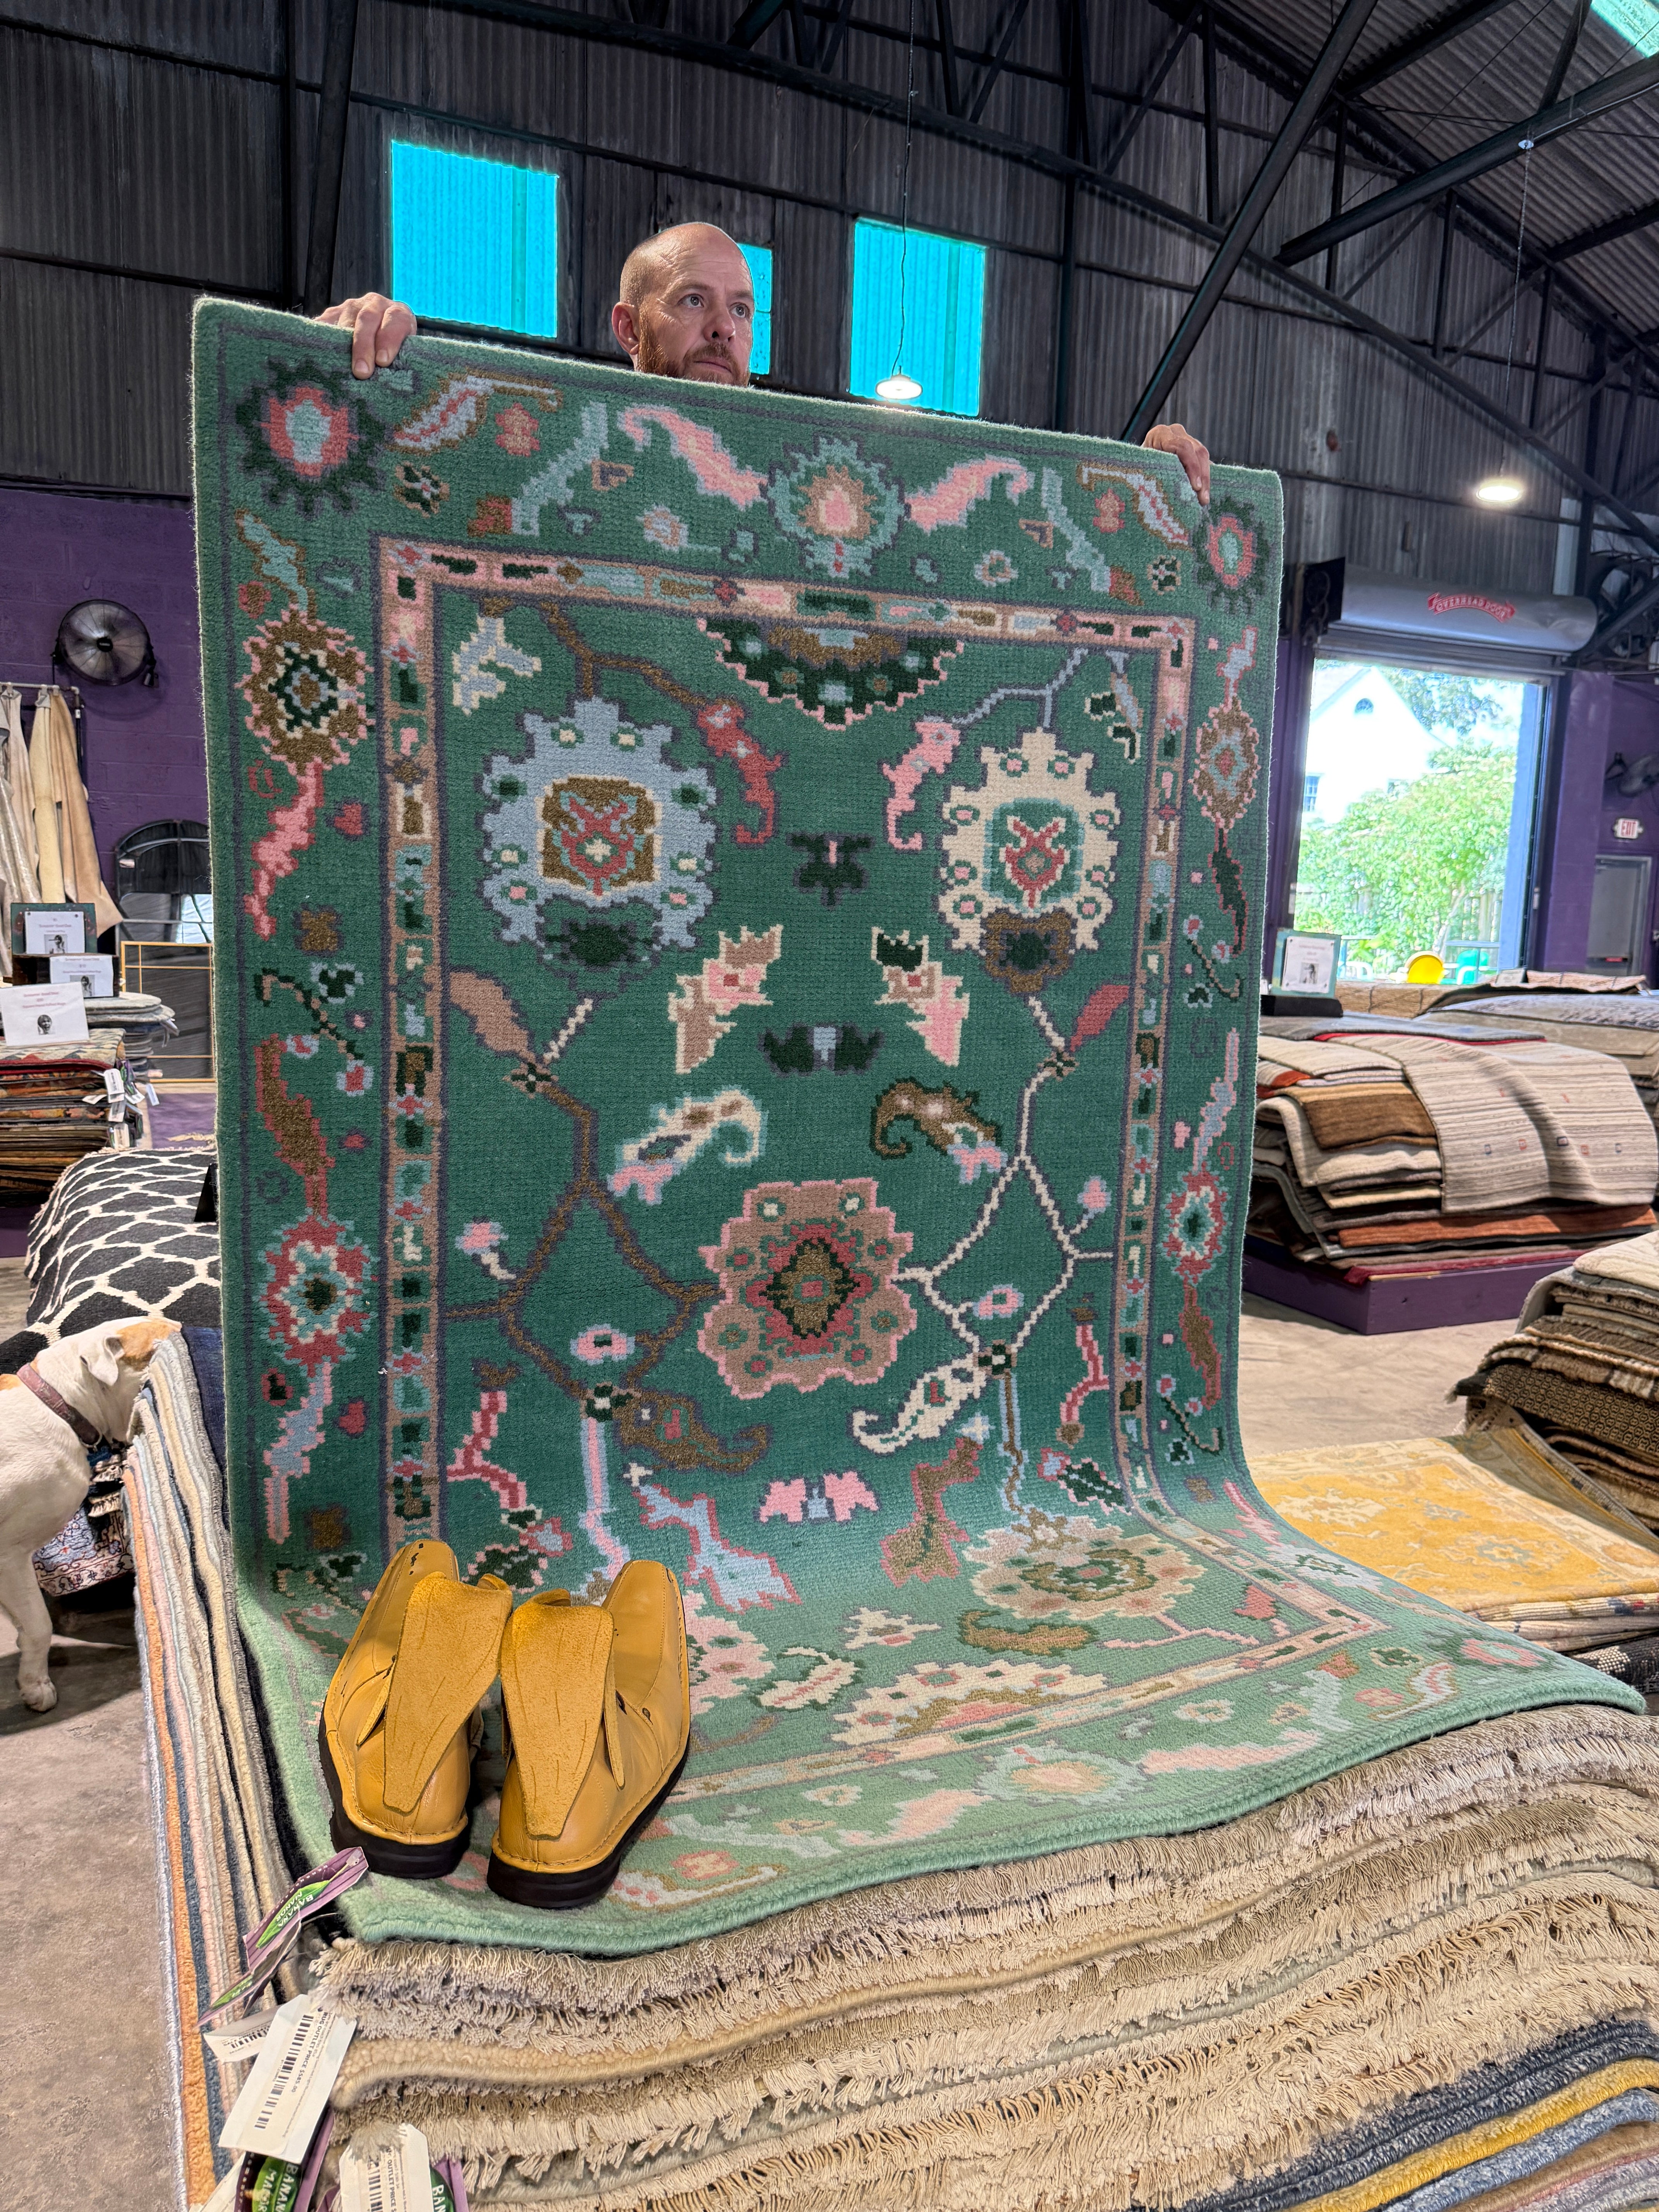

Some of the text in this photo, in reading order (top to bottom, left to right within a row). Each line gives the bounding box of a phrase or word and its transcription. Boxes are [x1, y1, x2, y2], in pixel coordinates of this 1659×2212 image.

[1436, 597, 1505, 619] OVERHEAD DOOR
[1621, 821, 1636, 836] EXIT
[319, 2012, 328, 2025] RUG
[310, 2026, 322, 2049] OUTLET
[302, 2050, 312, 2068] PRICE
[275, 2163, 299, 2212] BANAN
